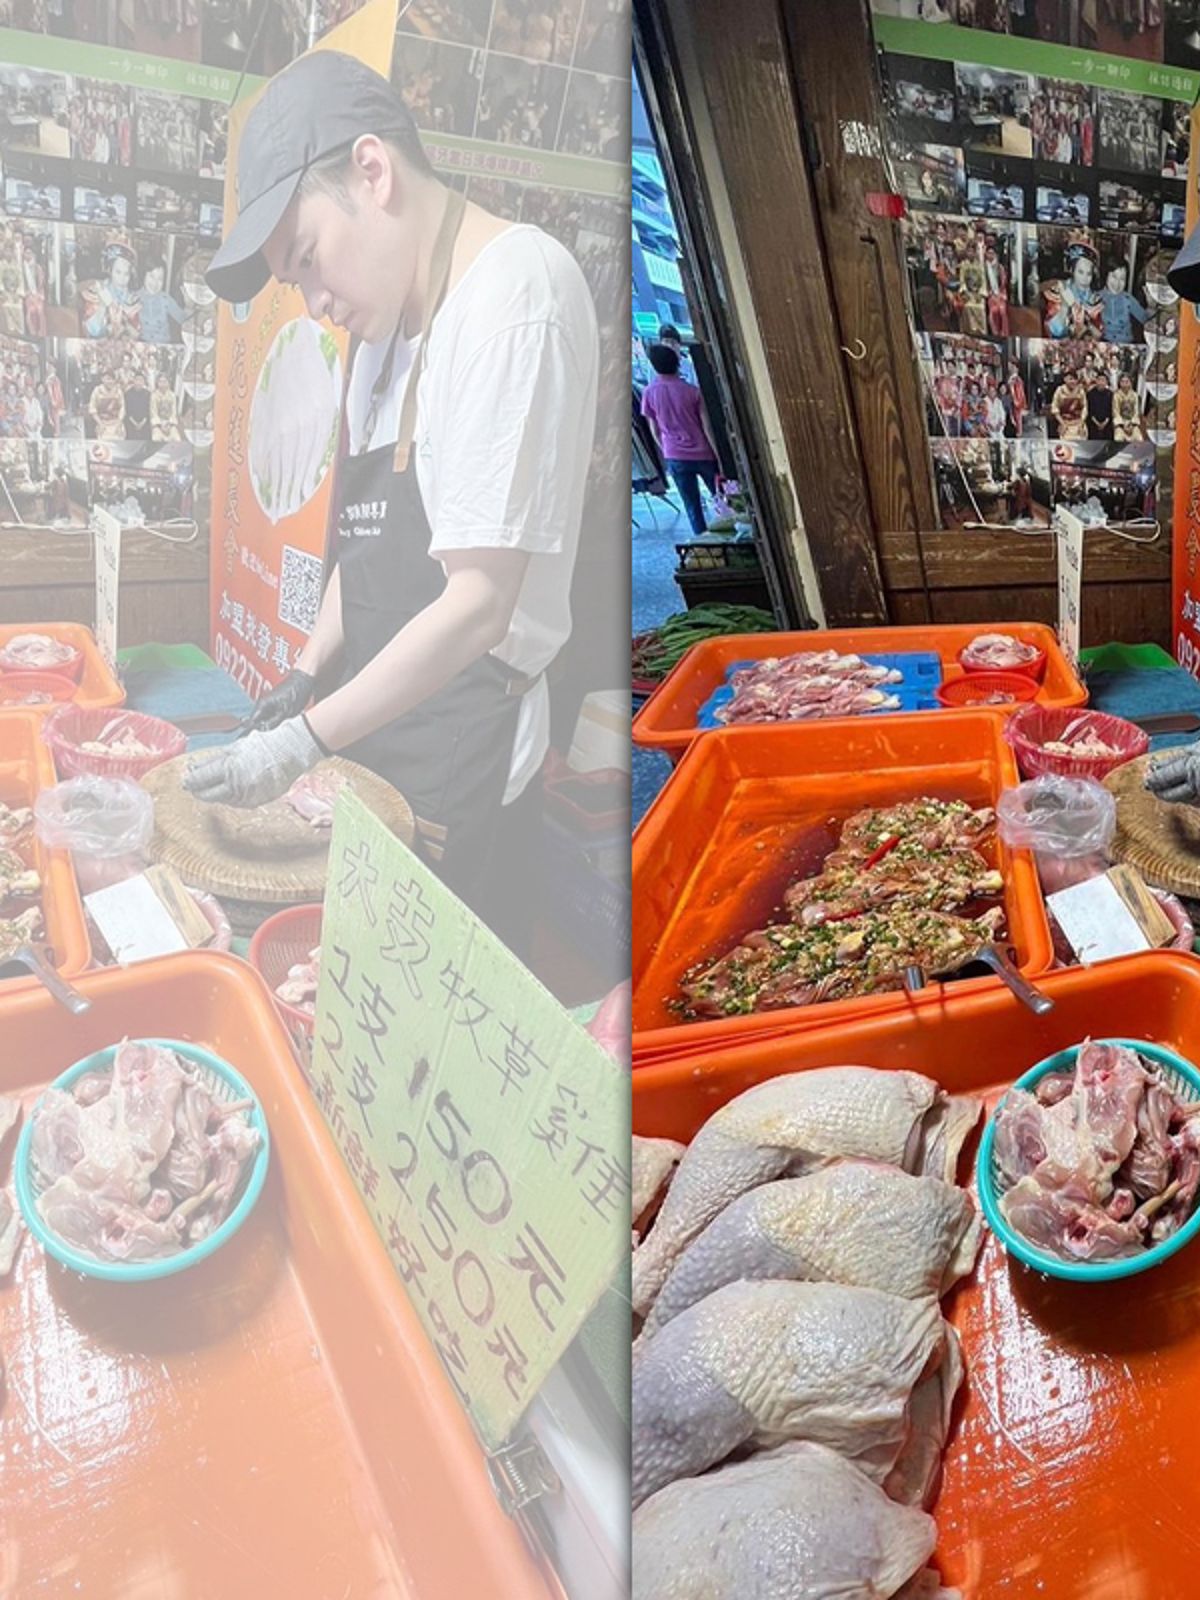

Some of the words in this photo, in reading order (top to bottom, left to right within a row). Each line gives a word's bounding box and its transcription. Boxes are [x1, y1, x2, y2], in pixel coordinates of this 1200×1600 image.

[219, 588, 303, 675] 加盟批發專
